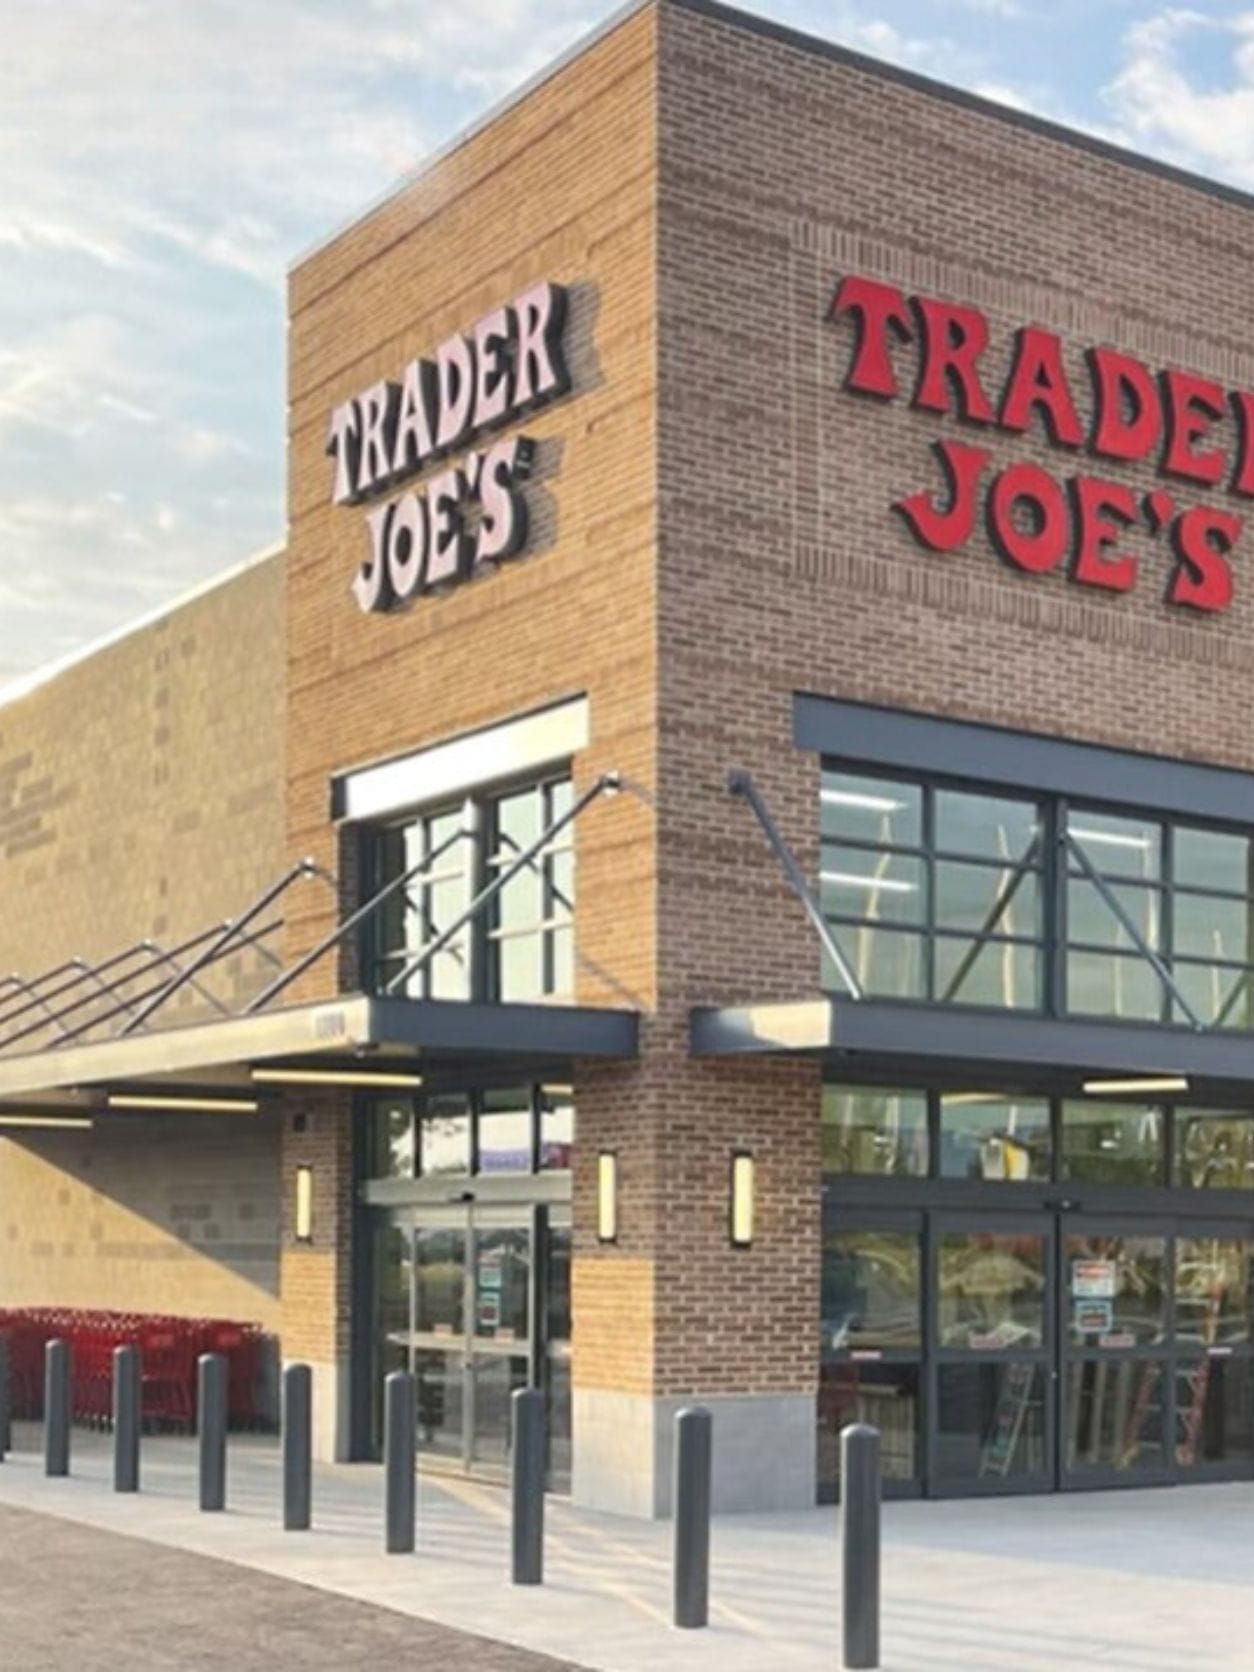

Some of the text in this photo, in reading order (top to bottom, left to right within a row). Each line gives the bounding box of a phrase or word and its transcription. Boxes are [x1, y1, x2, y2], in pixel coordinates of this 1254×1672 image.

[328, 281, 558, 505] TRADER
[351, 436, 522, 615] JOE'S
[896, 441, 1242, 613] JOE'S
